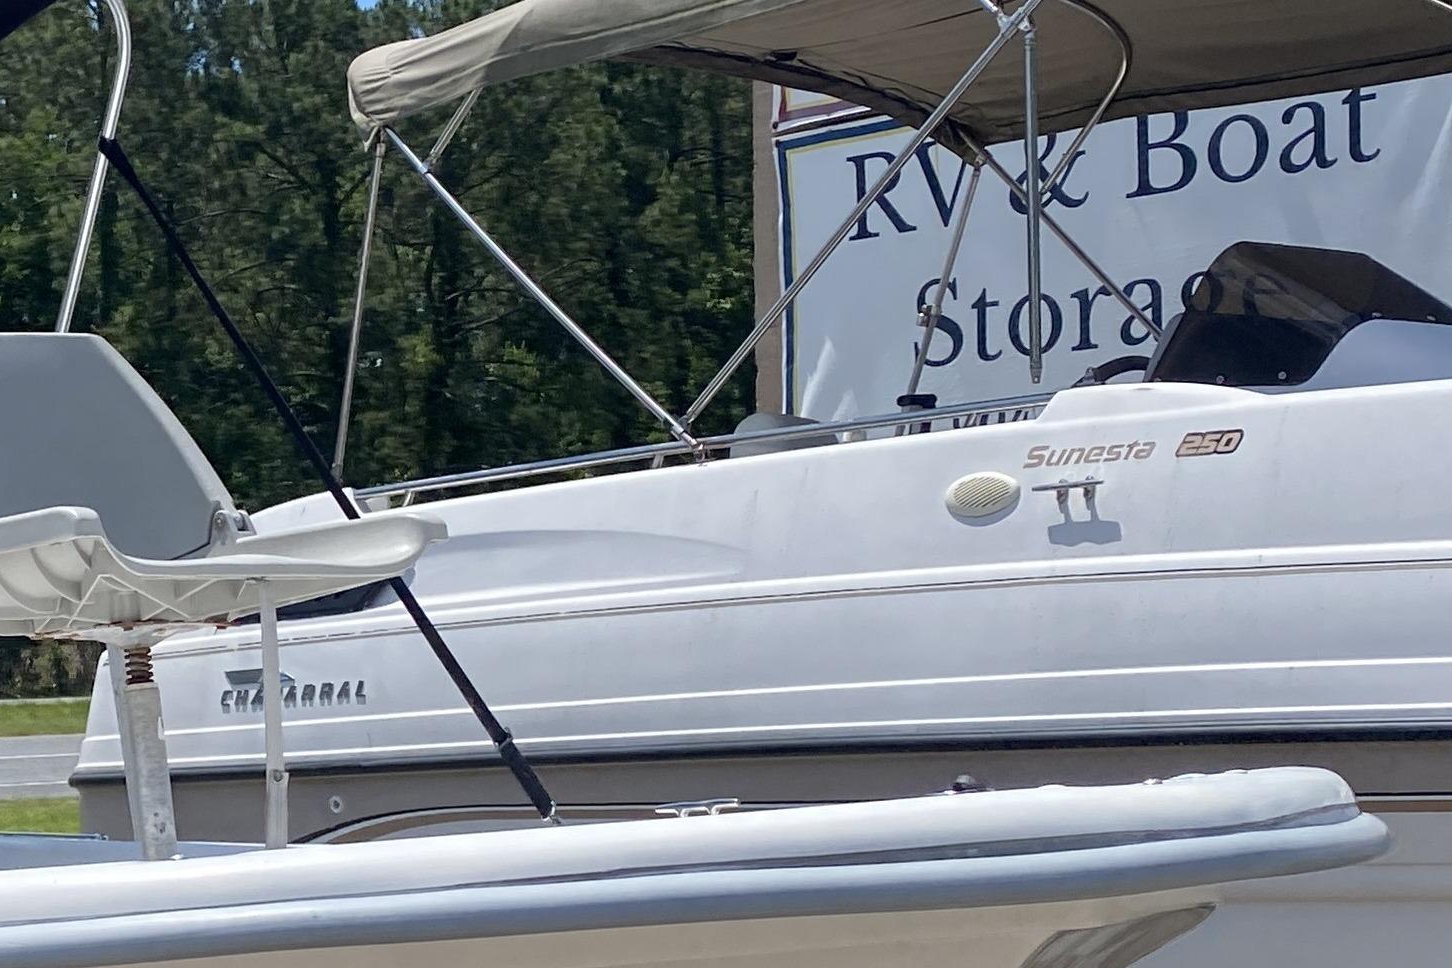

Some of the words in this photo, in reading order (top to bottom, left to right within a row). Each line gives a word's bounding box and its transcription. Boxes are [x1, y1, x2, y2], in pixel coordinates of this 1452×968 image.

[846, 141, 967, 242] RV
[1126, 88, 1381, 200] Boat
[1023, 440, 1156, 469] Sunesta
[1175, 429, 1244, 458] 250
[220, 680, 367, 707] CHAARRAL
